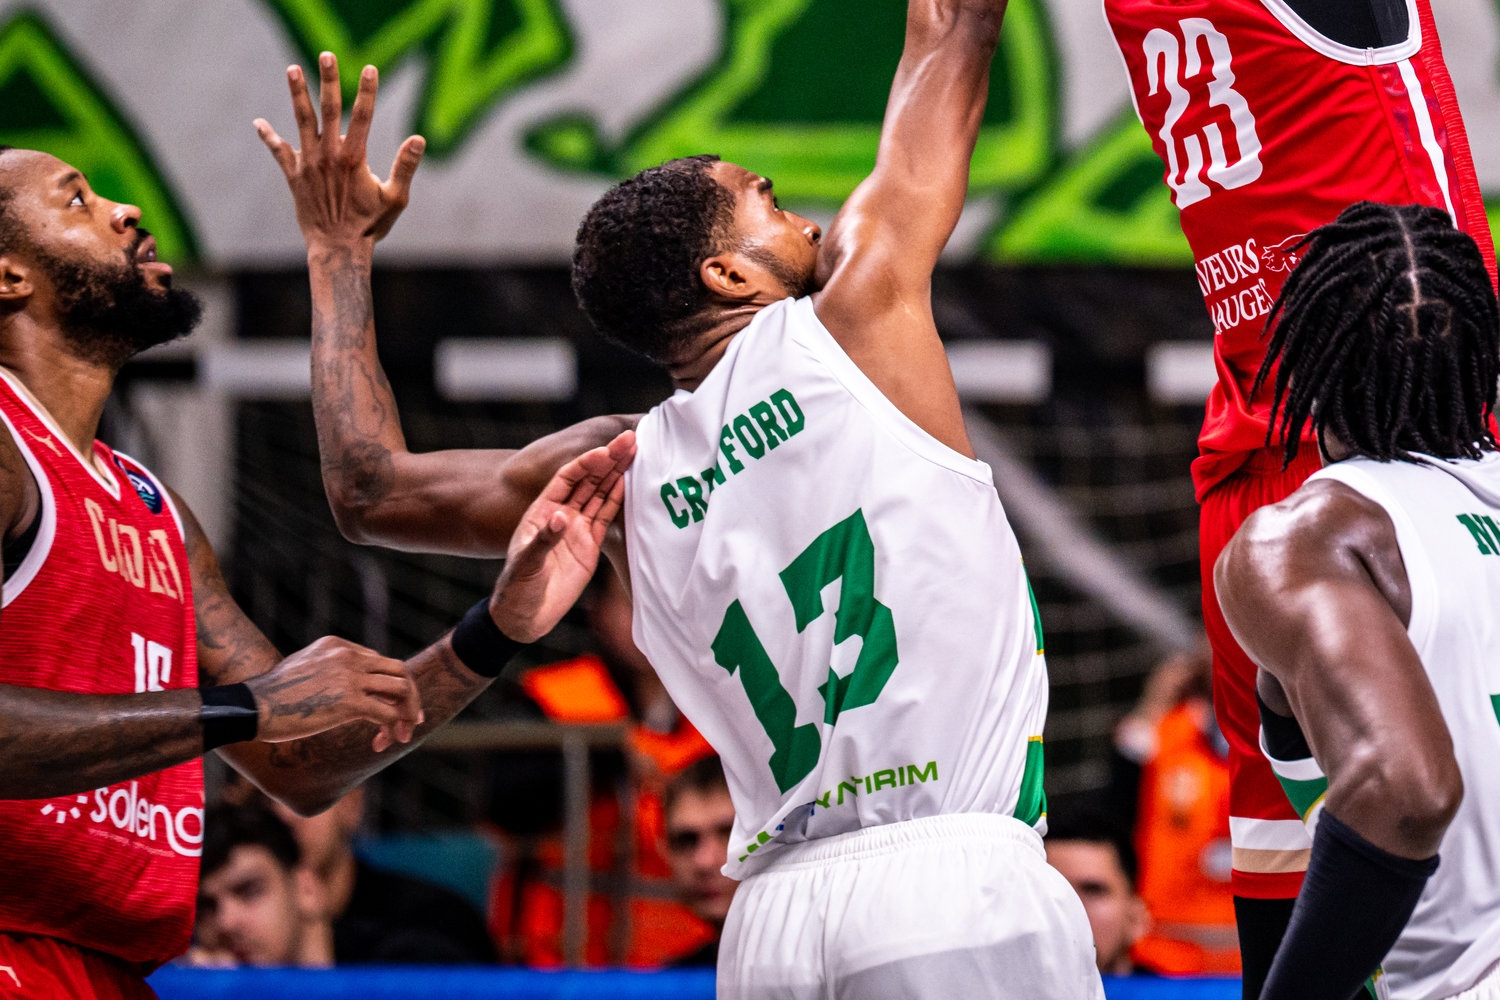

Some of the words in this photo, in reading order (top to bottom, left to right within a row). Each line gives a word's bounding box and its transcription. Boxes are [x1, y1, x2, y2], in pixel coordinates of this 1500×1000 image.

[1142, 18, 1263, 210] 23
[660, 388, 805, 530] CRFORD
[711, 508, 899, 795] 13
